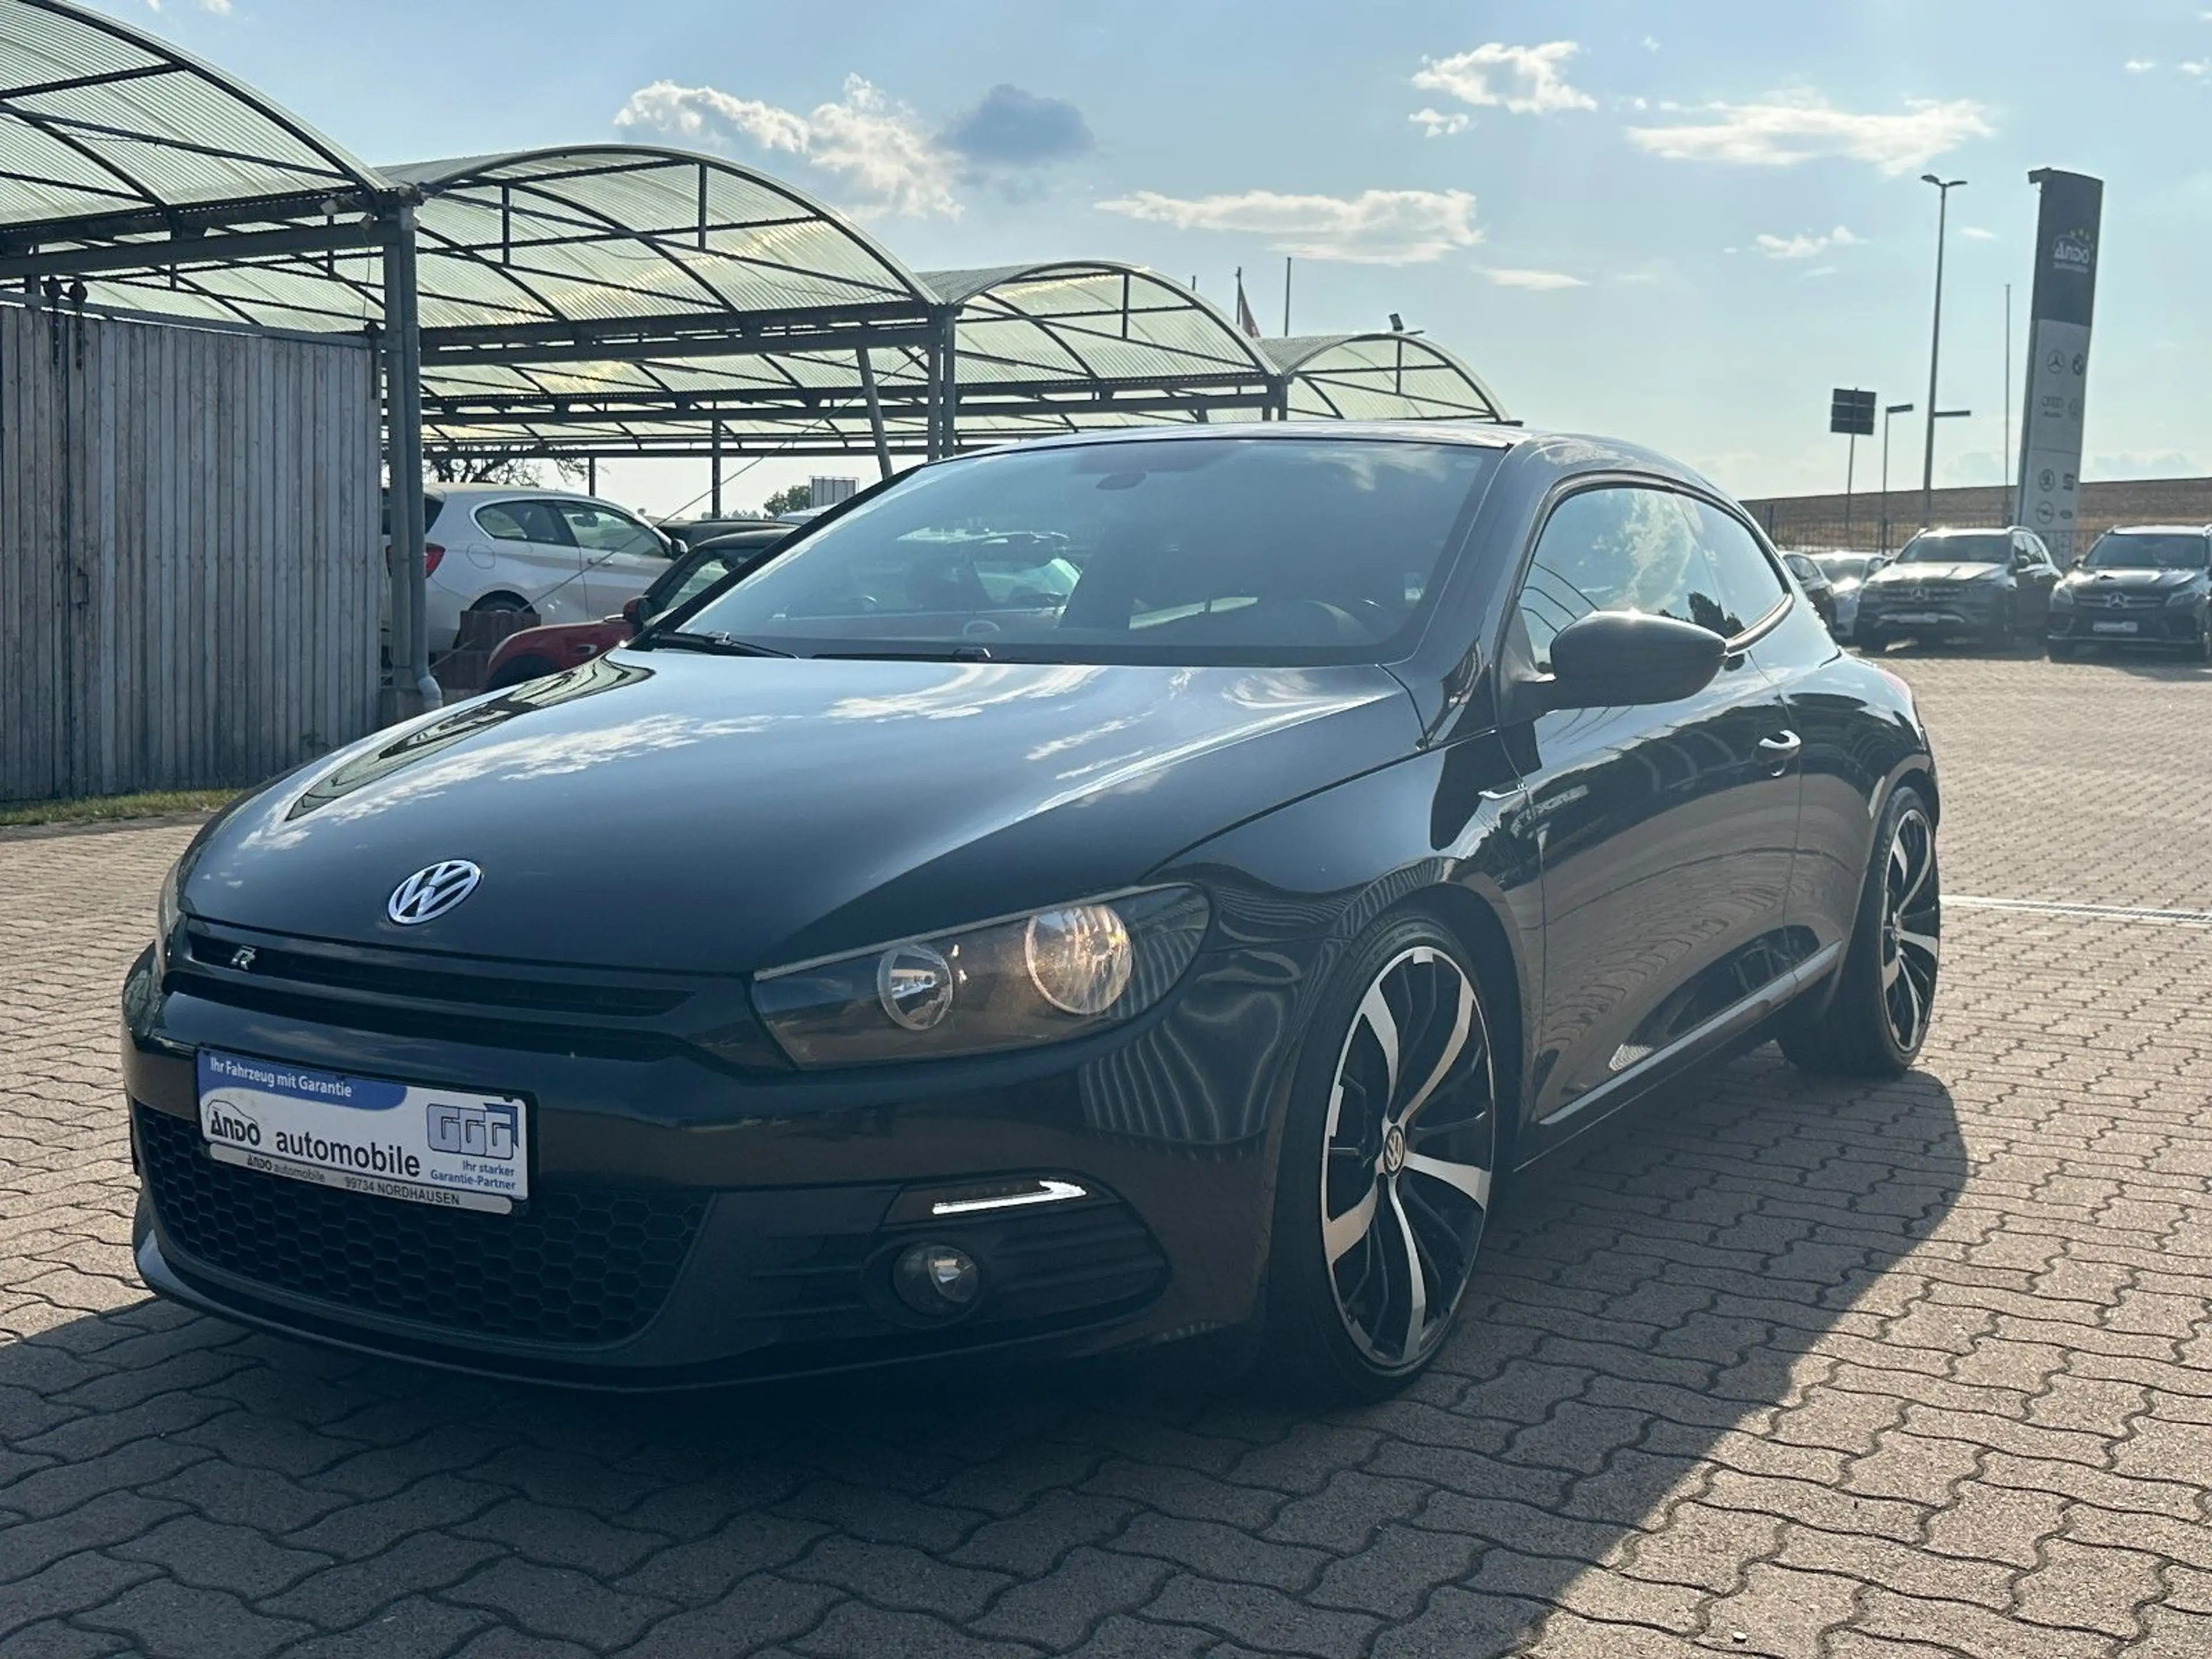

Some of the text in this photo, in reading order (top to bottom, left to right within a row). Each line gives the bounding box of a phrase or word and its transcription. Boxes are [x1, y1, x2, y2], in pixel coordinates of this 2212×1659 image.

[210, 1056, 352, 1097] Ihr Fahrzeug mit Garantie
[276, 1130, 421, 1177] automobile
[463, 1160, 515, 1177] Ihr starker
[274, 1163, 325, 1183] automobile
[345, 1176, 374, 1191] 99734
[377, 1181, 460, 1206] NORDHAUSEN
[430, 1169, 516, 1190] Garantie-Partner
